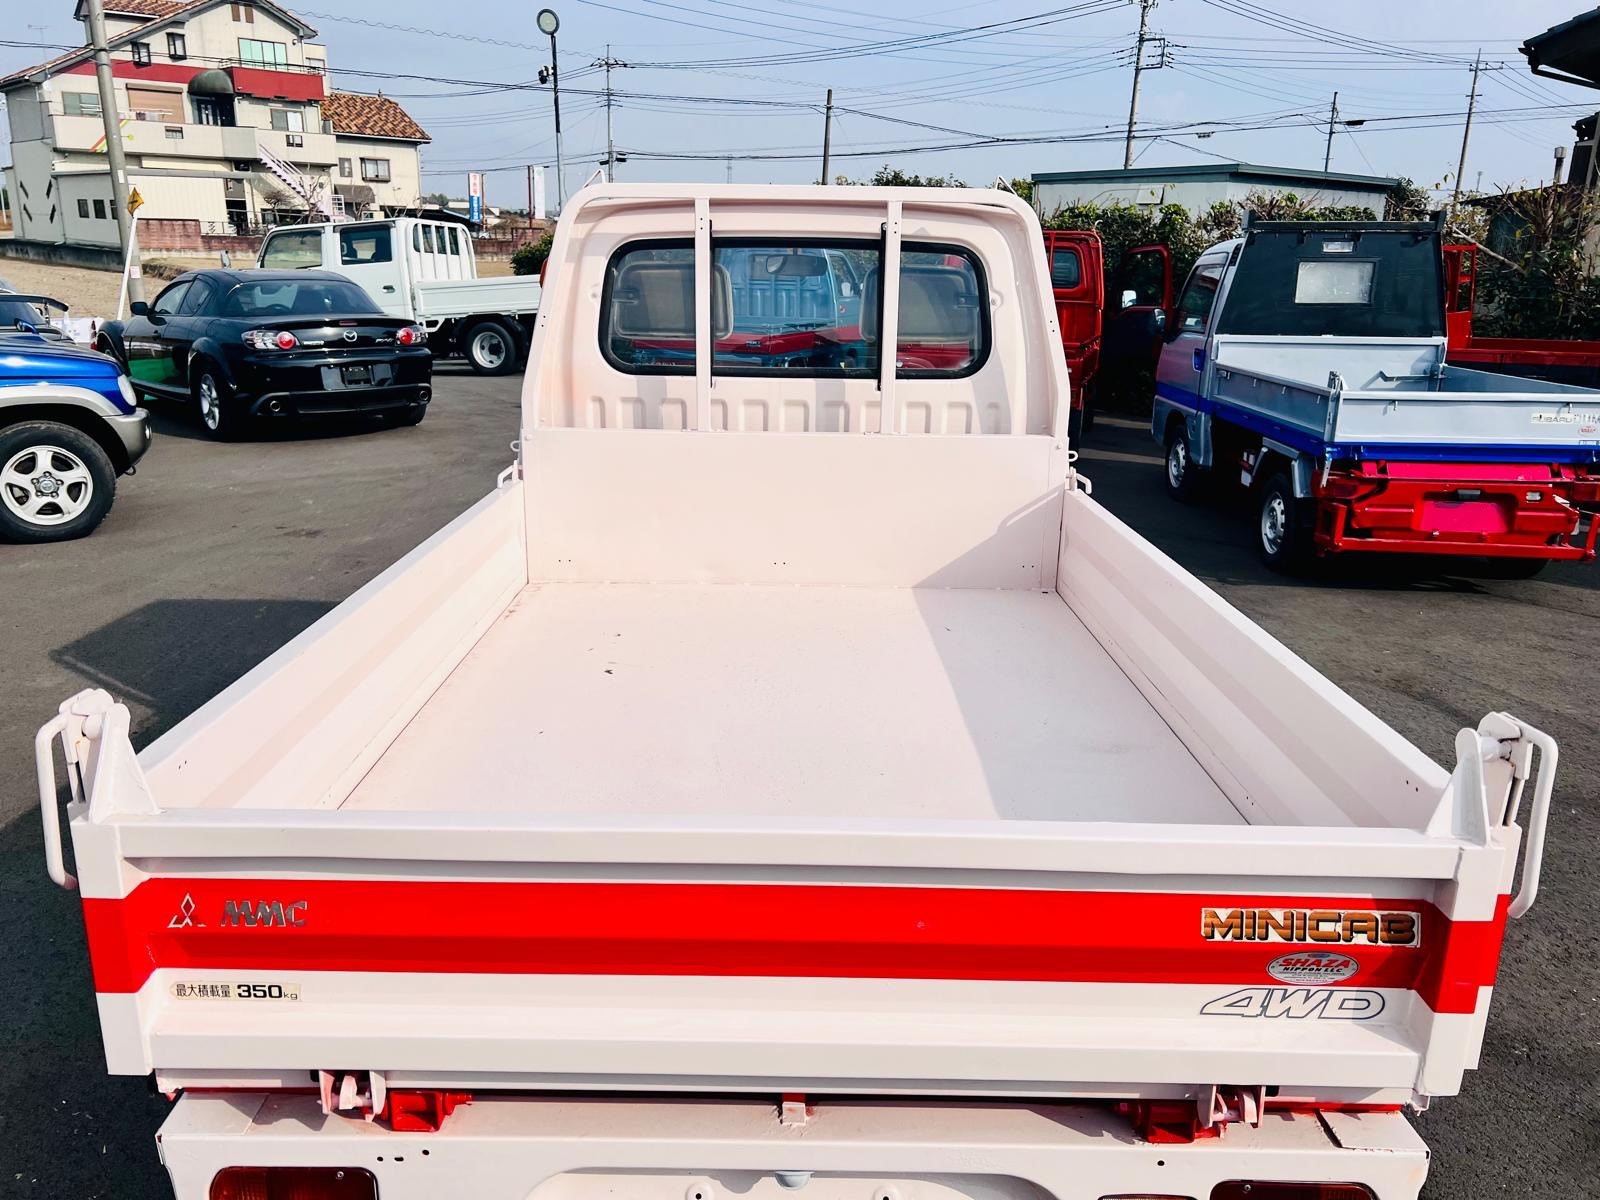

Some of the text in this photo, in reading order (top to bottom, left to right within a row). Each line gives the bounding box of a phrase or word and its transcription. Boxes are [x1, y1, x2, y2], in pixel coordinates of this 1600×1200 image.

[221, 900, 307, 927] MMC
[1203, 909, 1416, 944] MINICAB
[1279, 958, 1351, 968] SHAZA
[176, 983, 231, 998] 最大積載量
[1200, 988, 1385, 1020] 4WD
